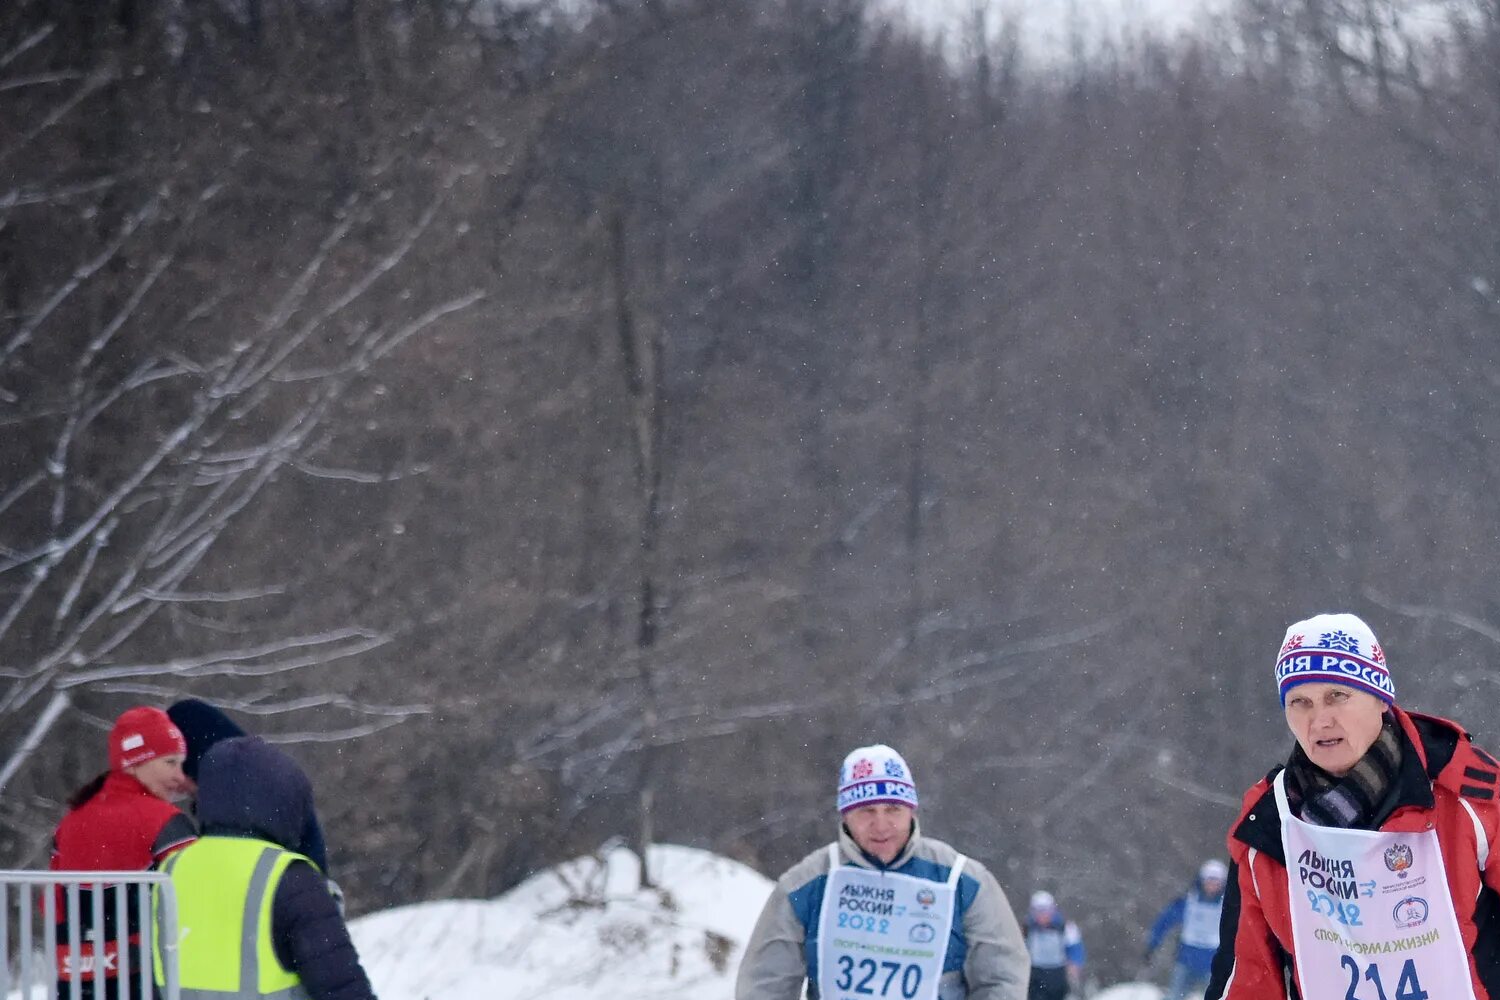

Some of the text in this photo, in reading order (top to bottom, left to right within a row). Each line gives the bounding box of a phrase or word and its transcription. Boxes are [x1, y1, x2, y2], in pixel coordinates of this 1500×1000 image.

[841, 884, 895, 901] ЛЫЖНЯ
[839, 896, 893, 915] РОССИИ
[838, 912, 889, 934] 2022
[1345, 934, 1392, 955] НОРМА
[1394, 928, 1439, 952] ЖИЗНИ
[836, 955, 922, 1000] 3270
